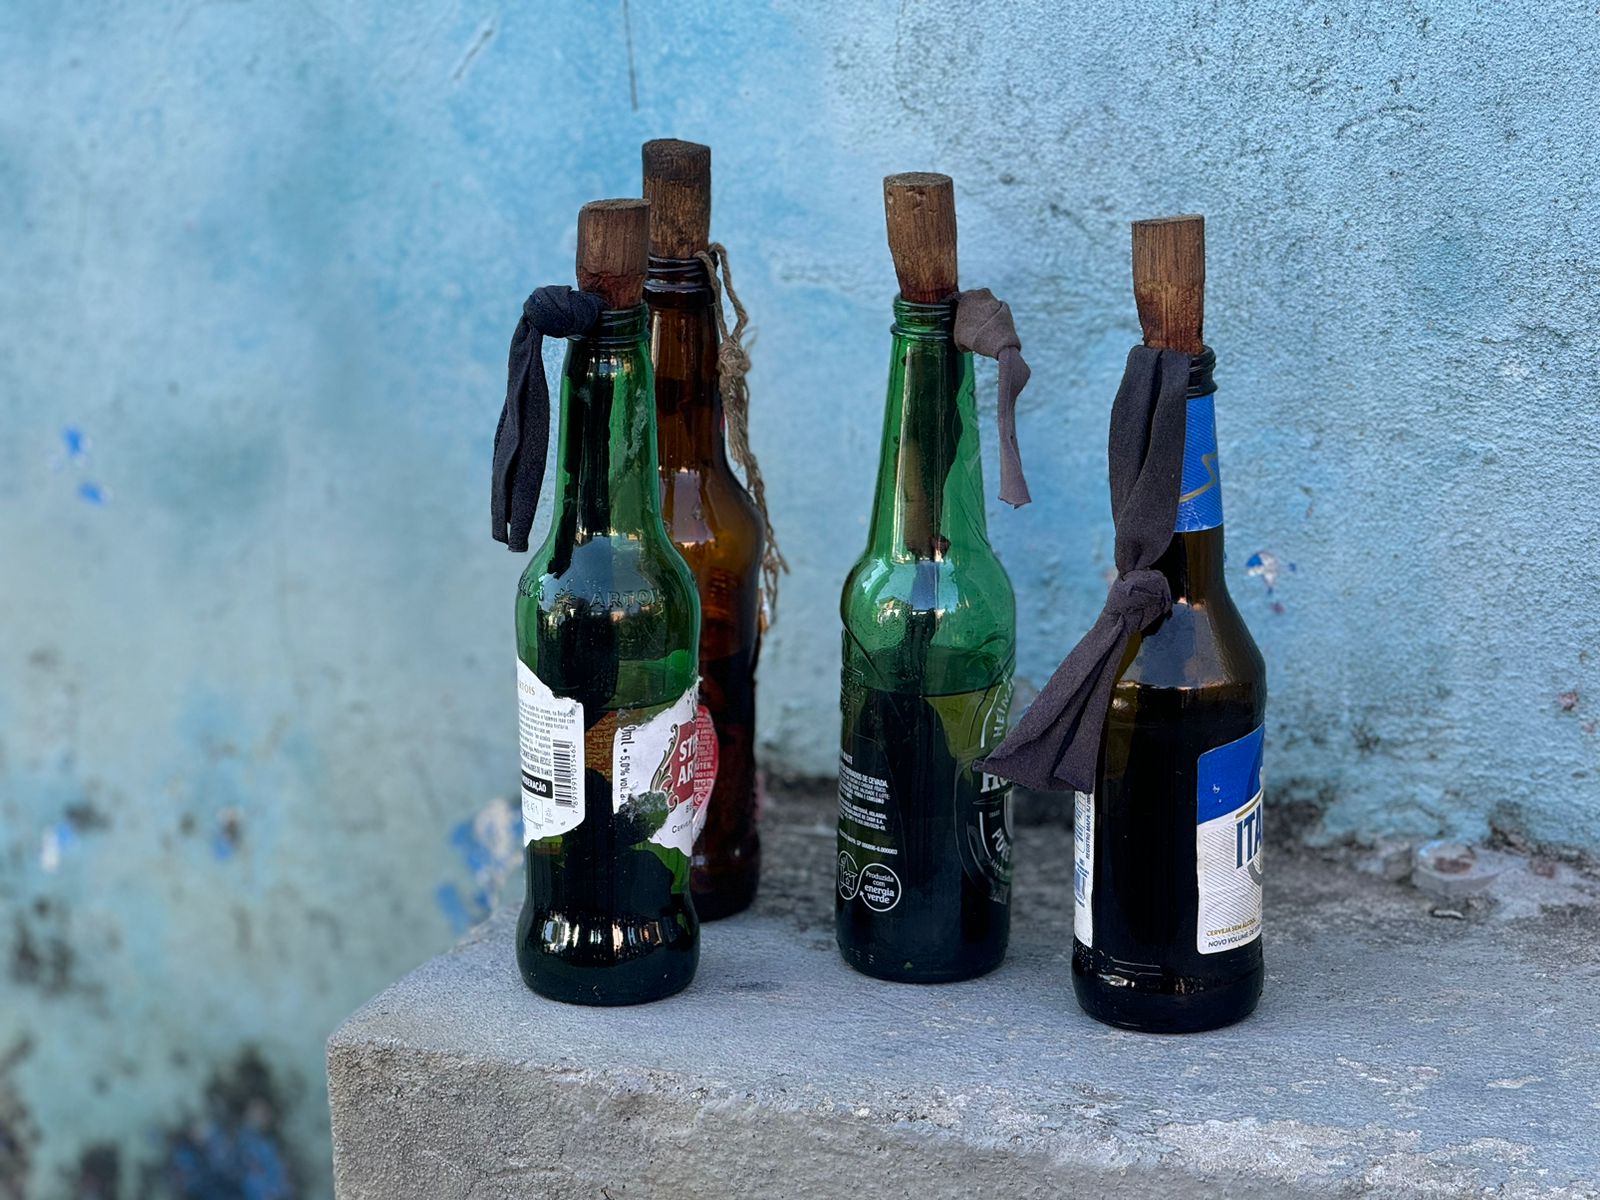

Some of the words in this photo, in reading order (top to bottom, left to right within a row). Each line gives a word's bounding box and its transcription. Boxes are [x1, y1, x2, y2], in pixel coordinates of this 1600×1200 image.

[588, 588, 662, 608] ARTOI
[619, 755, 631, 776] 5,0%
[865, 870, 894, 883] Produzida
[864, 884, 895, 897] energia
[867, 893, 890, 904] verde
[1207, 927, 1231, 937] CERVEJA
[1208, 938, 1228, 948] NOVO
[1228, 931, 1249, 943] VOLUME
